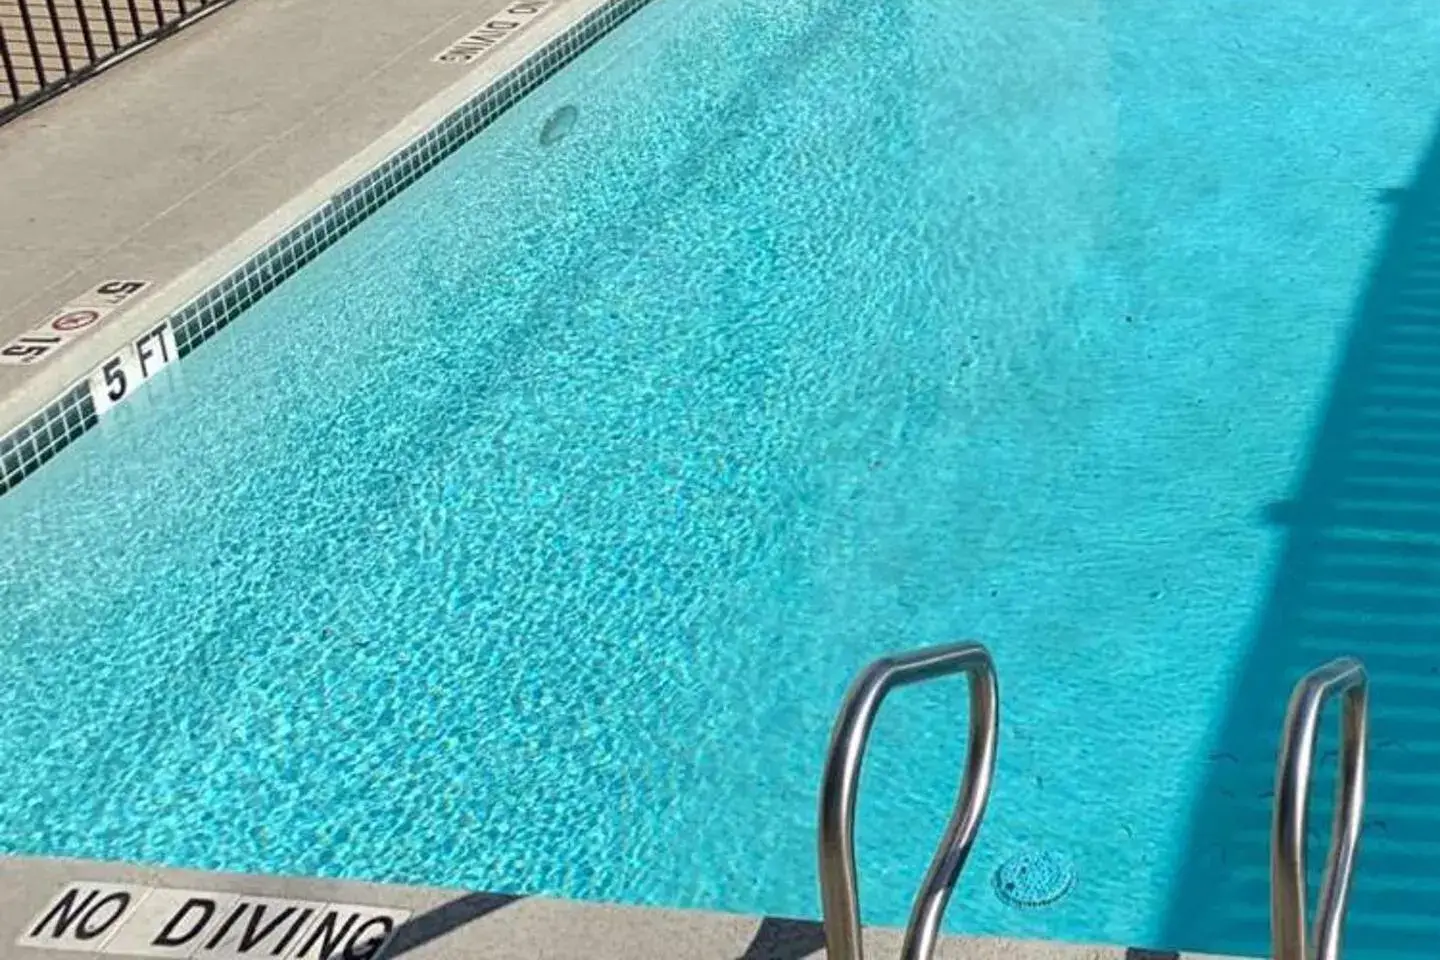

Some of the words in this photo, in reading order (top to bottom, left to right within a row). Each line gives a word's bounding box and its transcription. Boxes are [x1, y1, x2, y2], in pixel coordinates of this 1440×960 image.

[103, 357, 127, 402] 5
[136, 324, 168, 378] FT
[31, 888, 130, 940] NO
[152, 898, 394, 960] DIVING
